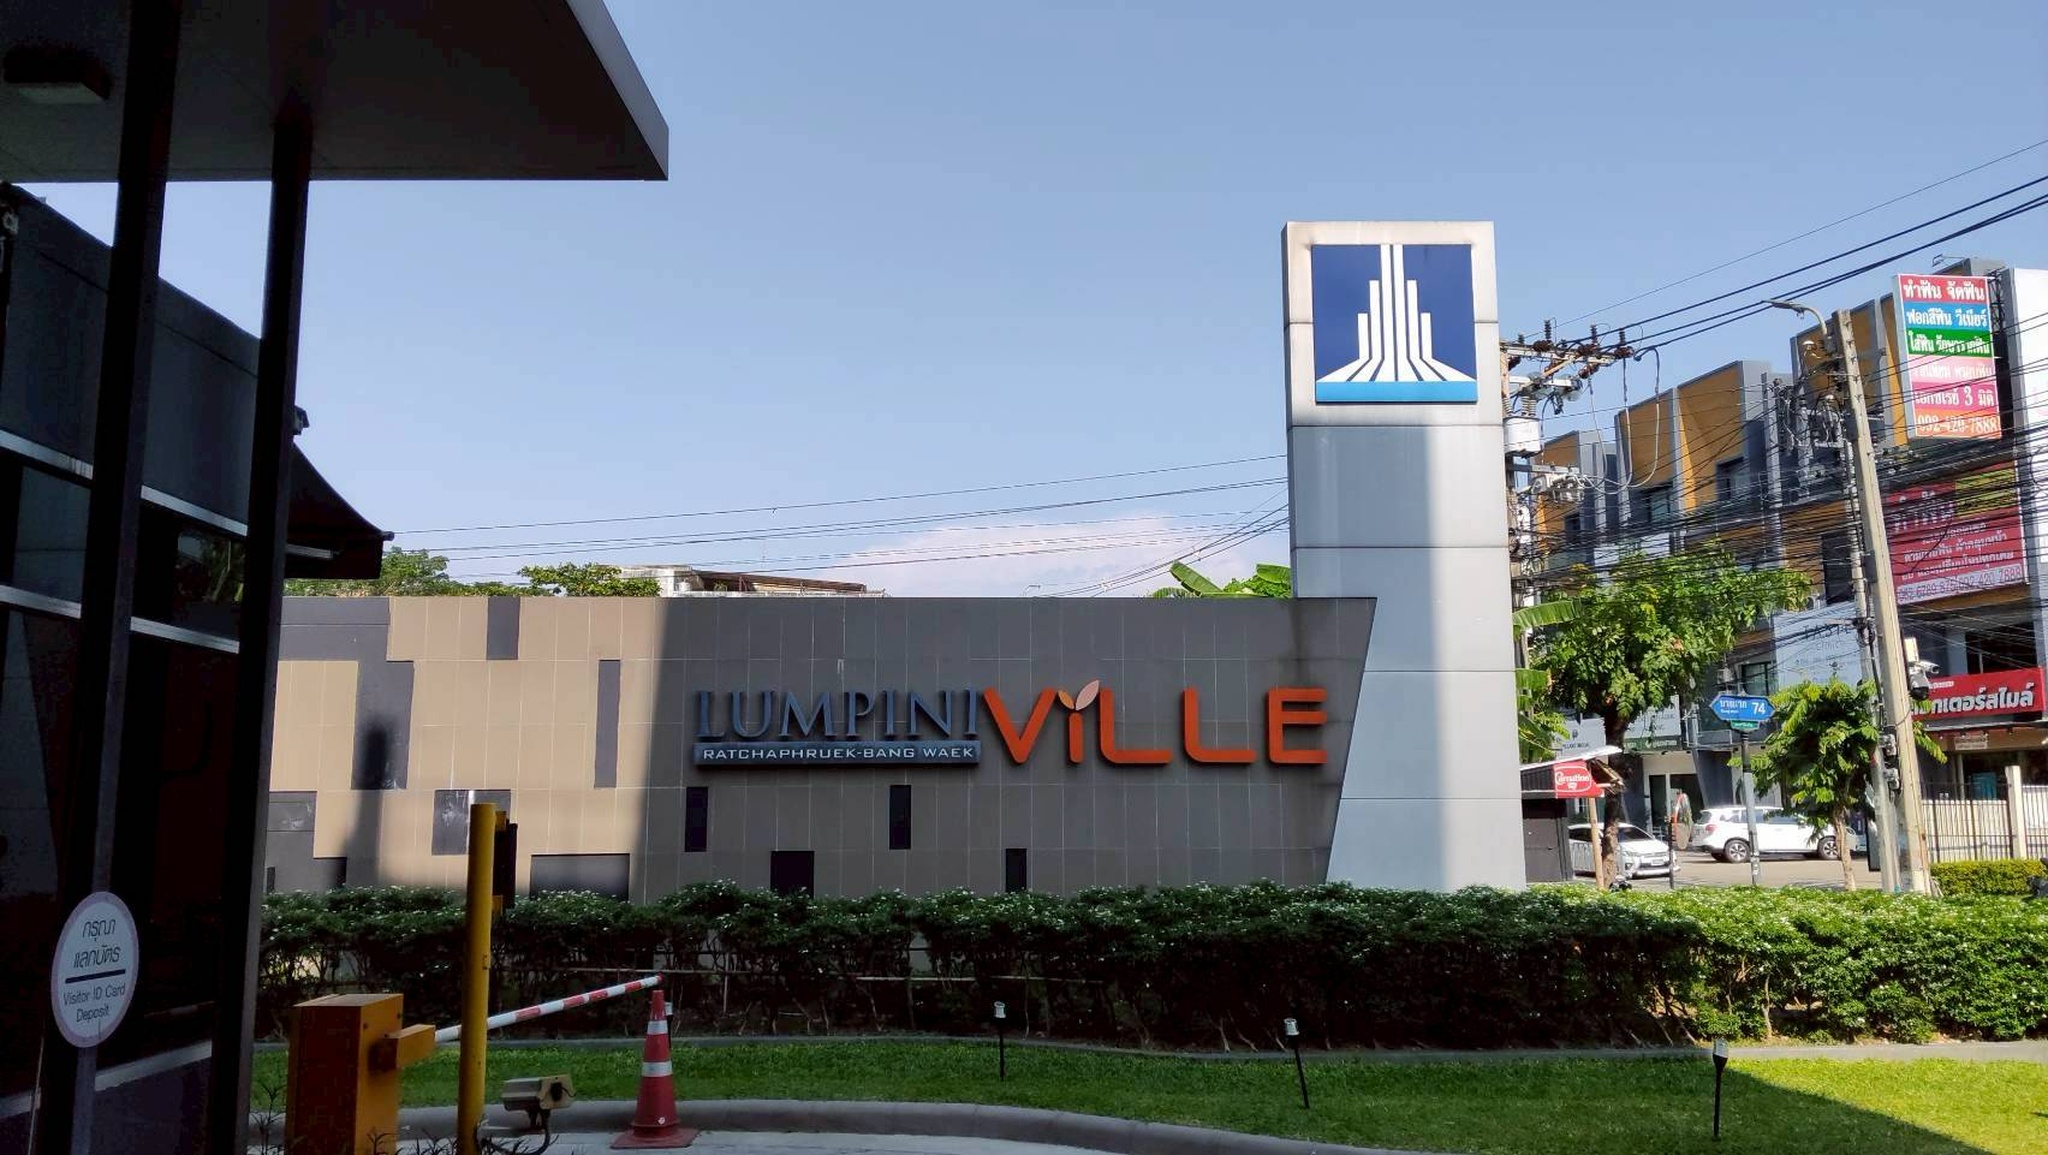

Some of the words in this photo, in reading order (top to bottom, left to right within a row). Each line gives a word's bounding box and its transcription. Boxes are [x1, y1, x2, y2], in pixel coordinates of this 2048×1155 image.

[1903, 279, 1941, 299] ทำฟัน
[1946, 280, 1985, 301] จัดฟัน
[1906, 306, 1952, 326] ฟอกสีฟัน
[1964, 386, 1973, 406] 3
[1978, 390, 1995, 407] มิติ
[697, 690, 980, 738] LUMPINI
[1752, 702, 1766, 715] 74
[702, 747, 915, 760] RATCHAPHRUEK-BANG
[922, 747, 973, 759] WAEK
[82, 919, 116, 942] กรุณา
[73, 945, 121, 969] แลกบัตร
[63, 990, 91, 1006] Visitor
[93, 986, 103, 1000] ID
[105, 983, 126, 998] Card
[76, 1004, 110, 1023] Deposit
